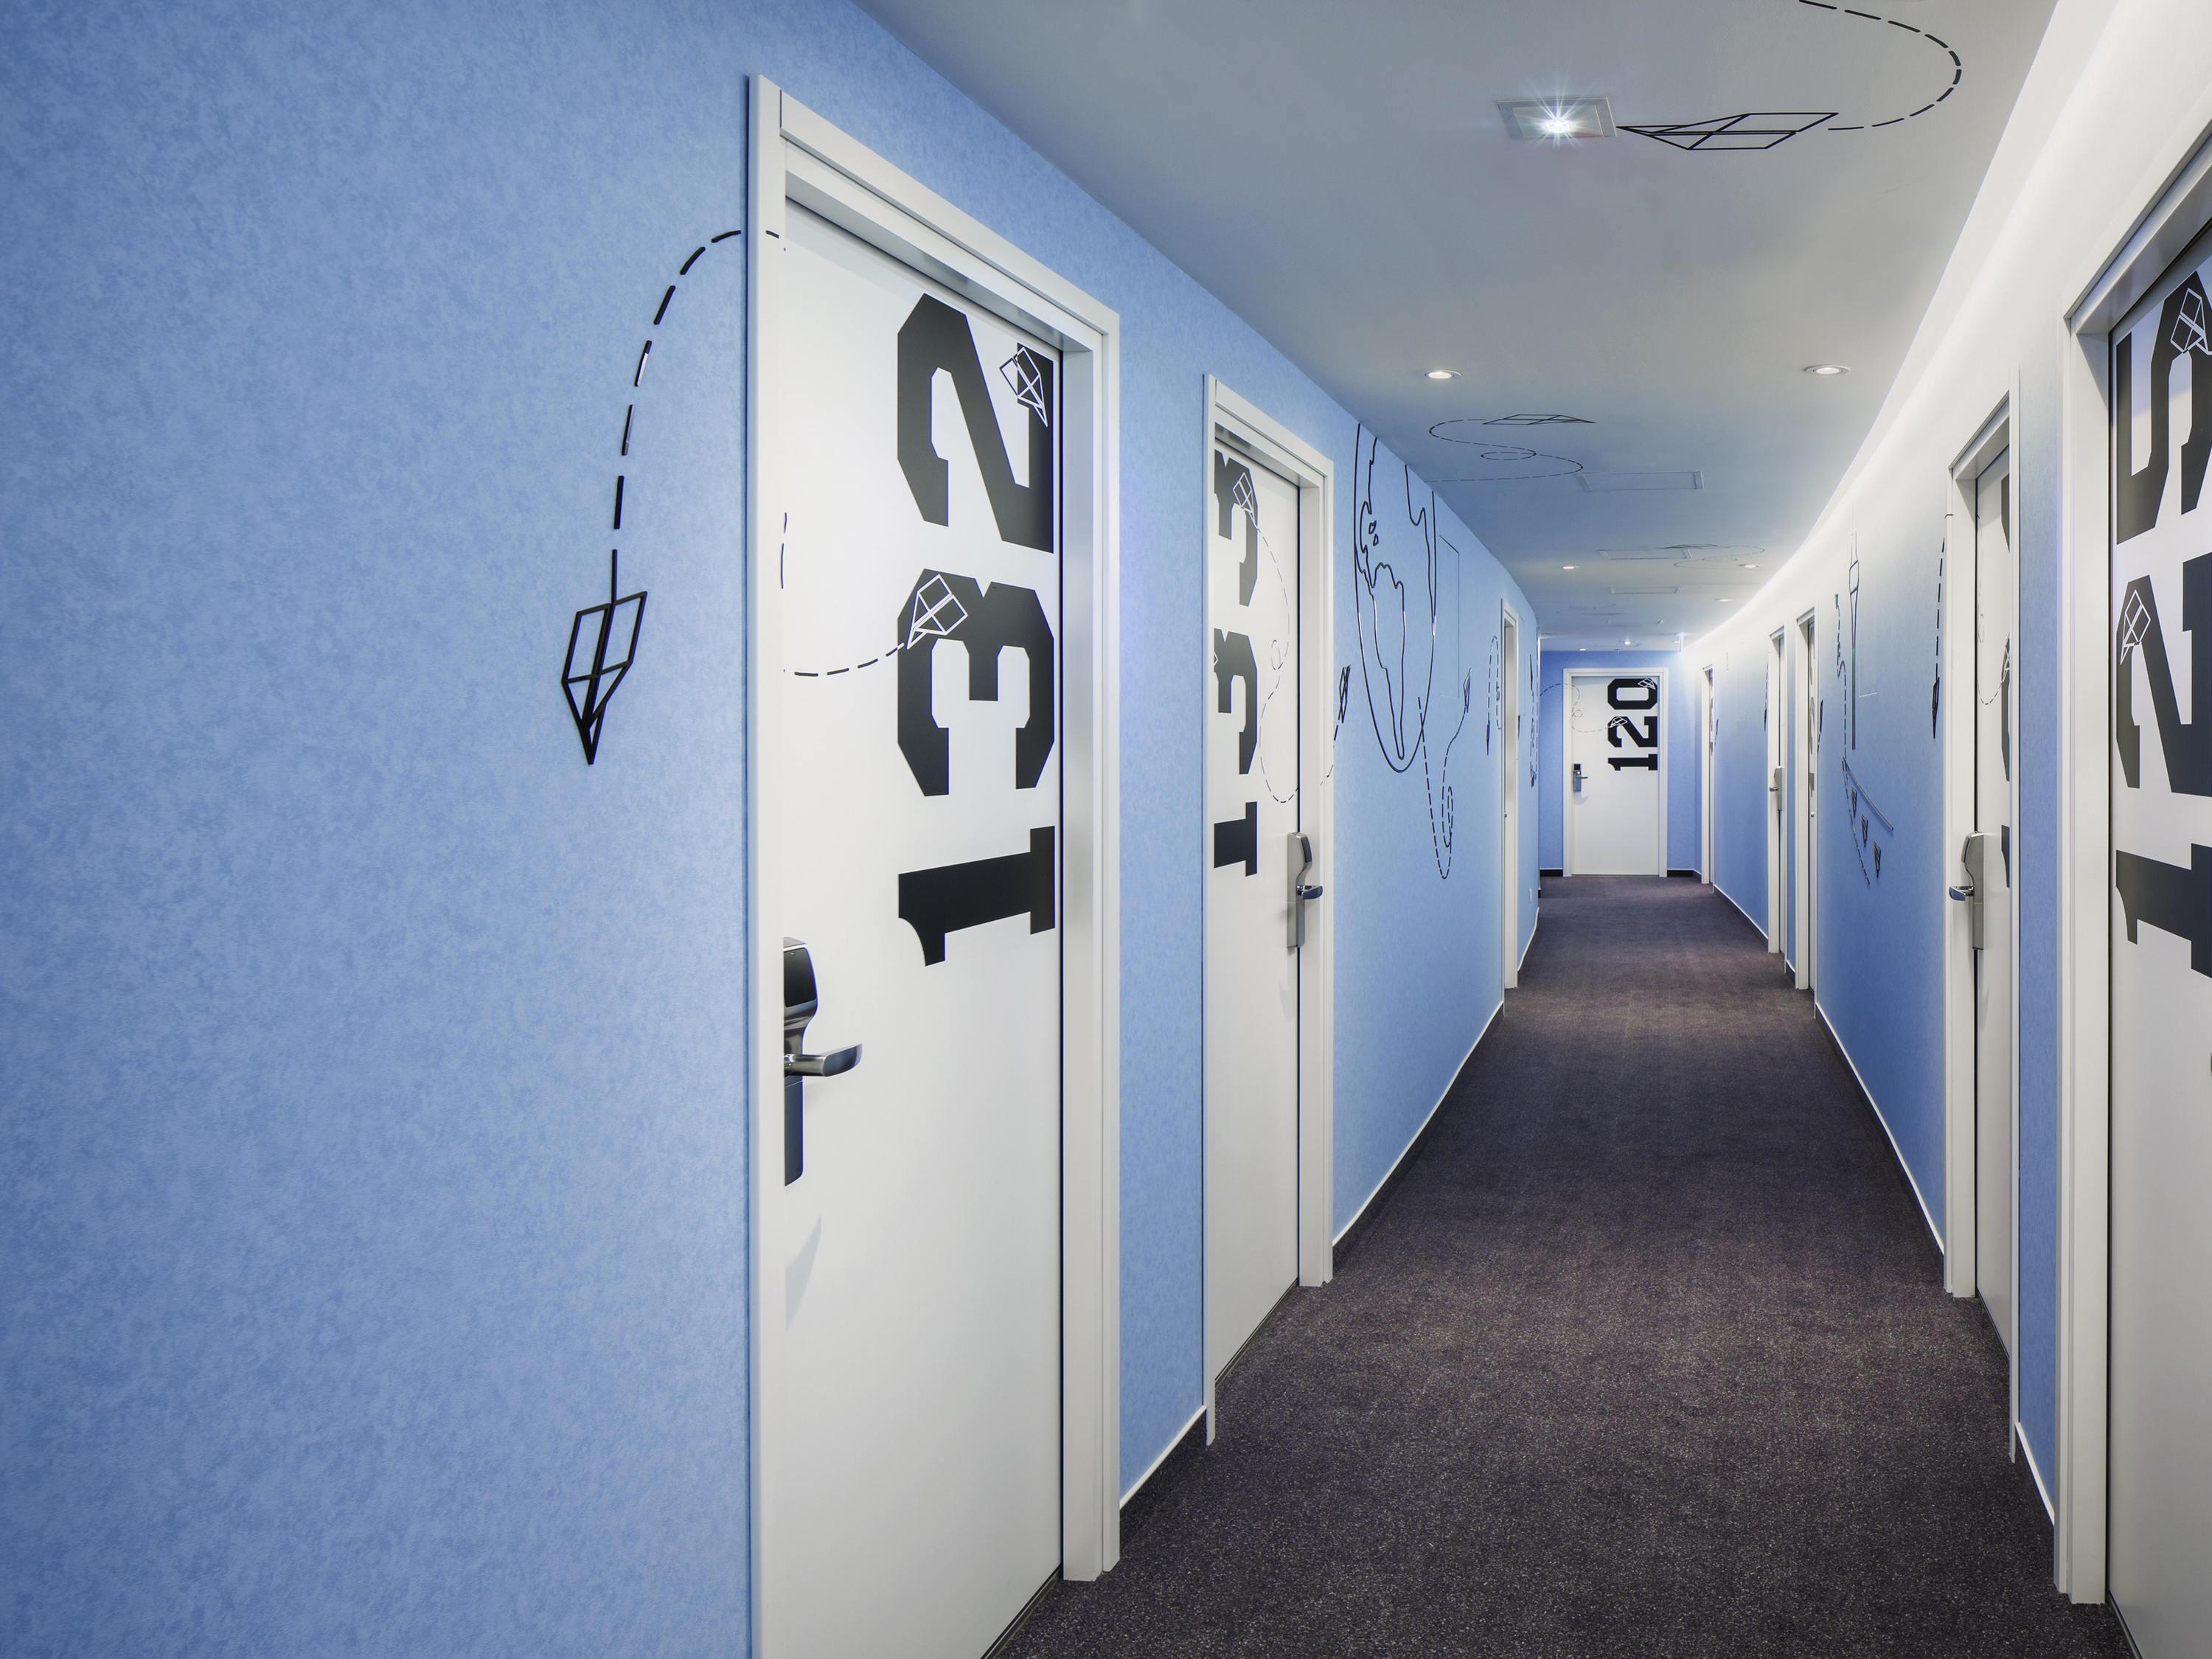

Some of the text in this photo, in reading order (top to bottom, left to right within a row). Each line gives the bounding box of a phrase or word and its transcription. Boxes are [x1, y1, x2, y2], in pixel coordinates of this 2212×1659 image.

[897, 293, 1055, 967] 132
[1607, 678, 1658, 771] 120
[2115, 270, 2212, 979] 125
